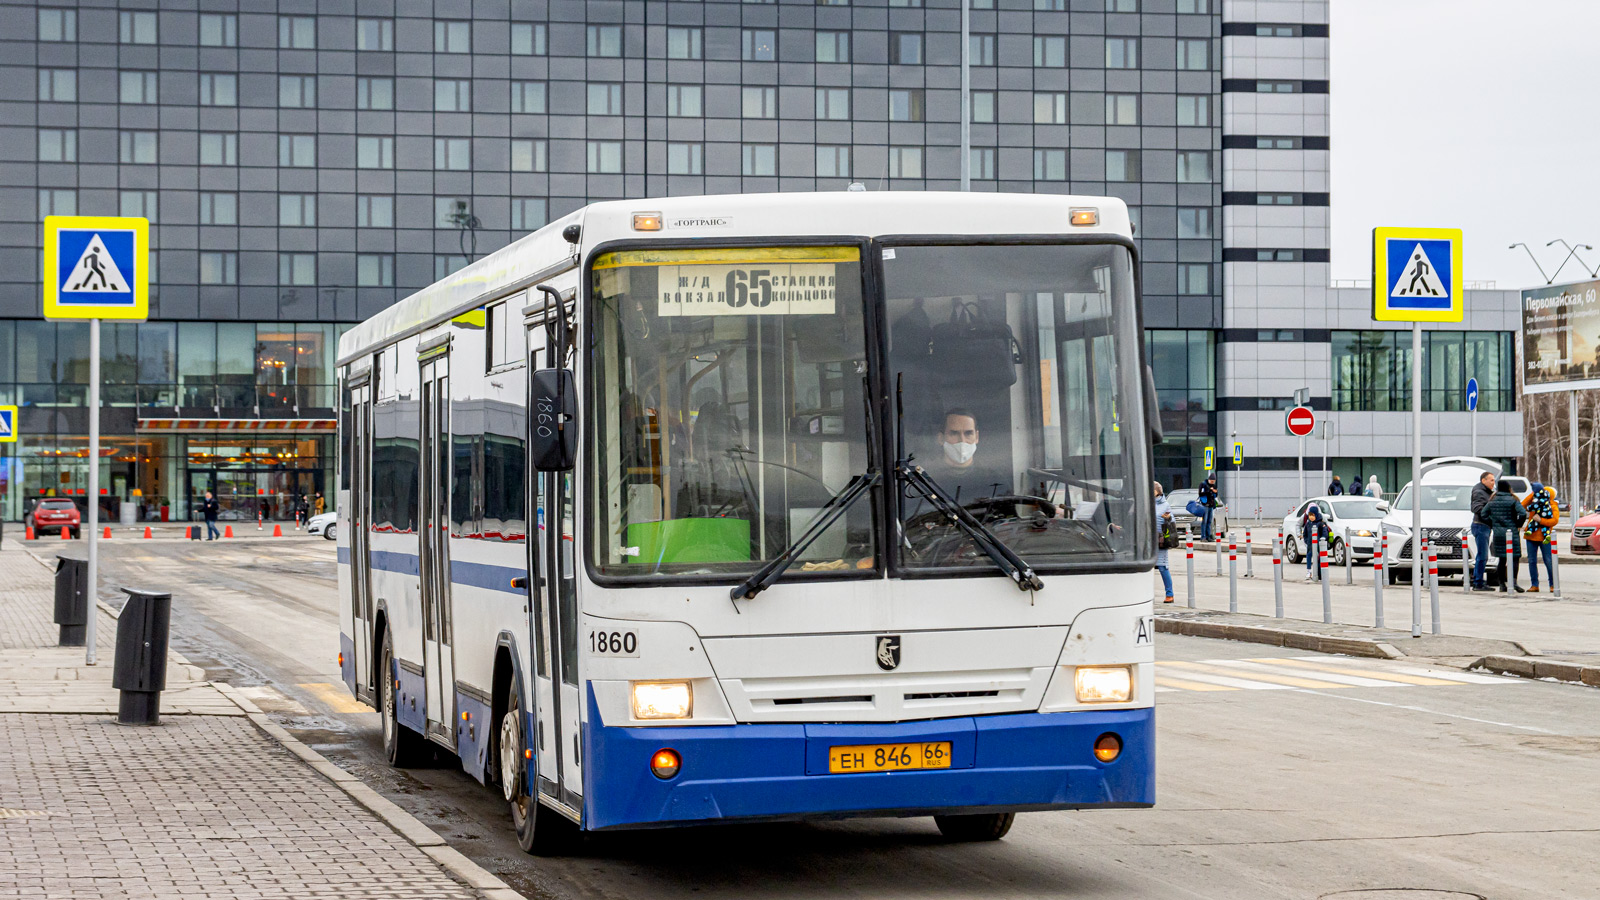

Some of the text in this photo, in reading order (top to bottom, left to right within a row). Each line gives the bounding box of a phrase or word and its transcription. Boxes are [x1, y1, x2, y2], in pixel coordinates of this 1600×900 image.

[674, 218, 726, 226] «ГОРТРАНС»
[725, 269, 772, 308] 65
[771, 275, 836, 288] СТАНЦИЯ
[663, 291, 726, 304] ВОКЗАЛ
[771, 289, 836, 302] КОЛЬЦОВО
[1526, 288, 1596, 313] Первомайская, 60
[537, 396, 553, 438] 1860
[589, 630, 637, 654] 1860
[841, 746, 912, 769] ЕН 846
[924, 744, 944, 760] 66
